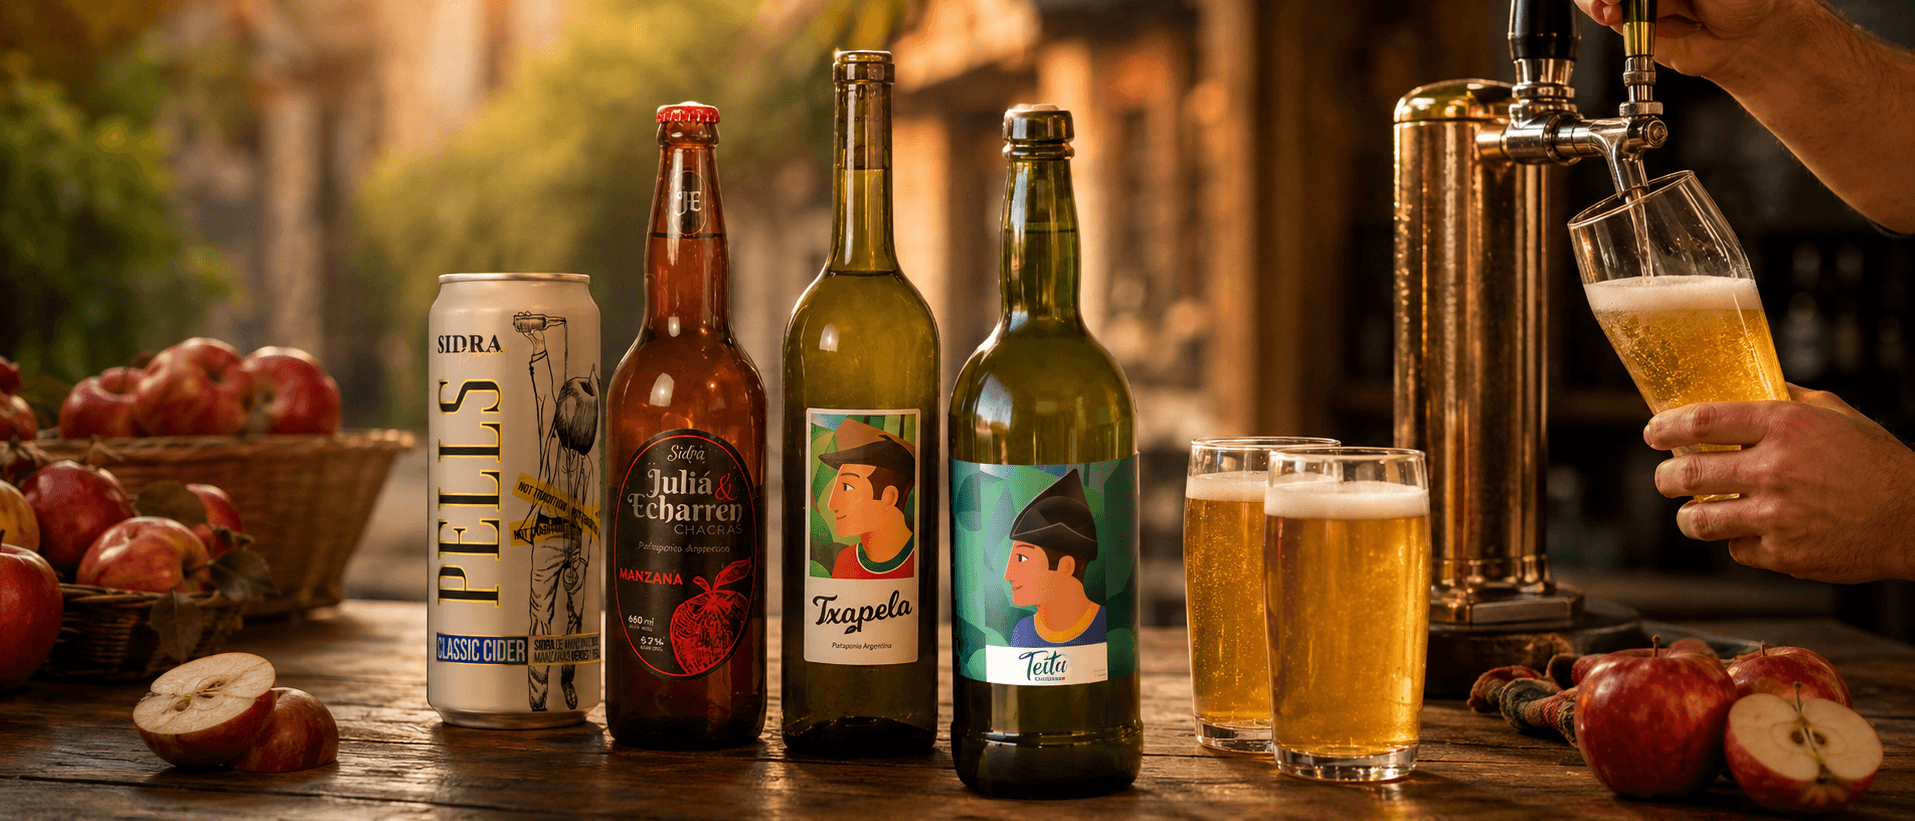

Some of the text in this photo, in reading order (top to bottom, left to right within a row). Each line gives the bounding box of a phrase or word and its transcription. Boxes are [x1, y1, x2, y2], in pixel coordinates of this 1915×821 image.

[437, 334, 503, 354] SIDRA
[667, 444, 706, 463] Sidra
[438, 378, 502, 609] PELLS
[517, 481, 535, 496] NOT
[646, 468, 738, 501] Juliá &
[627, 492, 743, 524] Echarren
[674, 523, 743, 535] CHACRAS
[619, 566, 684, 586] MANZANA
[628, 614, 643, 625] 660
[812, 589, 913, 633] Txapela
[437, 636, 526, 663] CLASSIC CIDER
[1018, 650, 1068, 681] Teita
